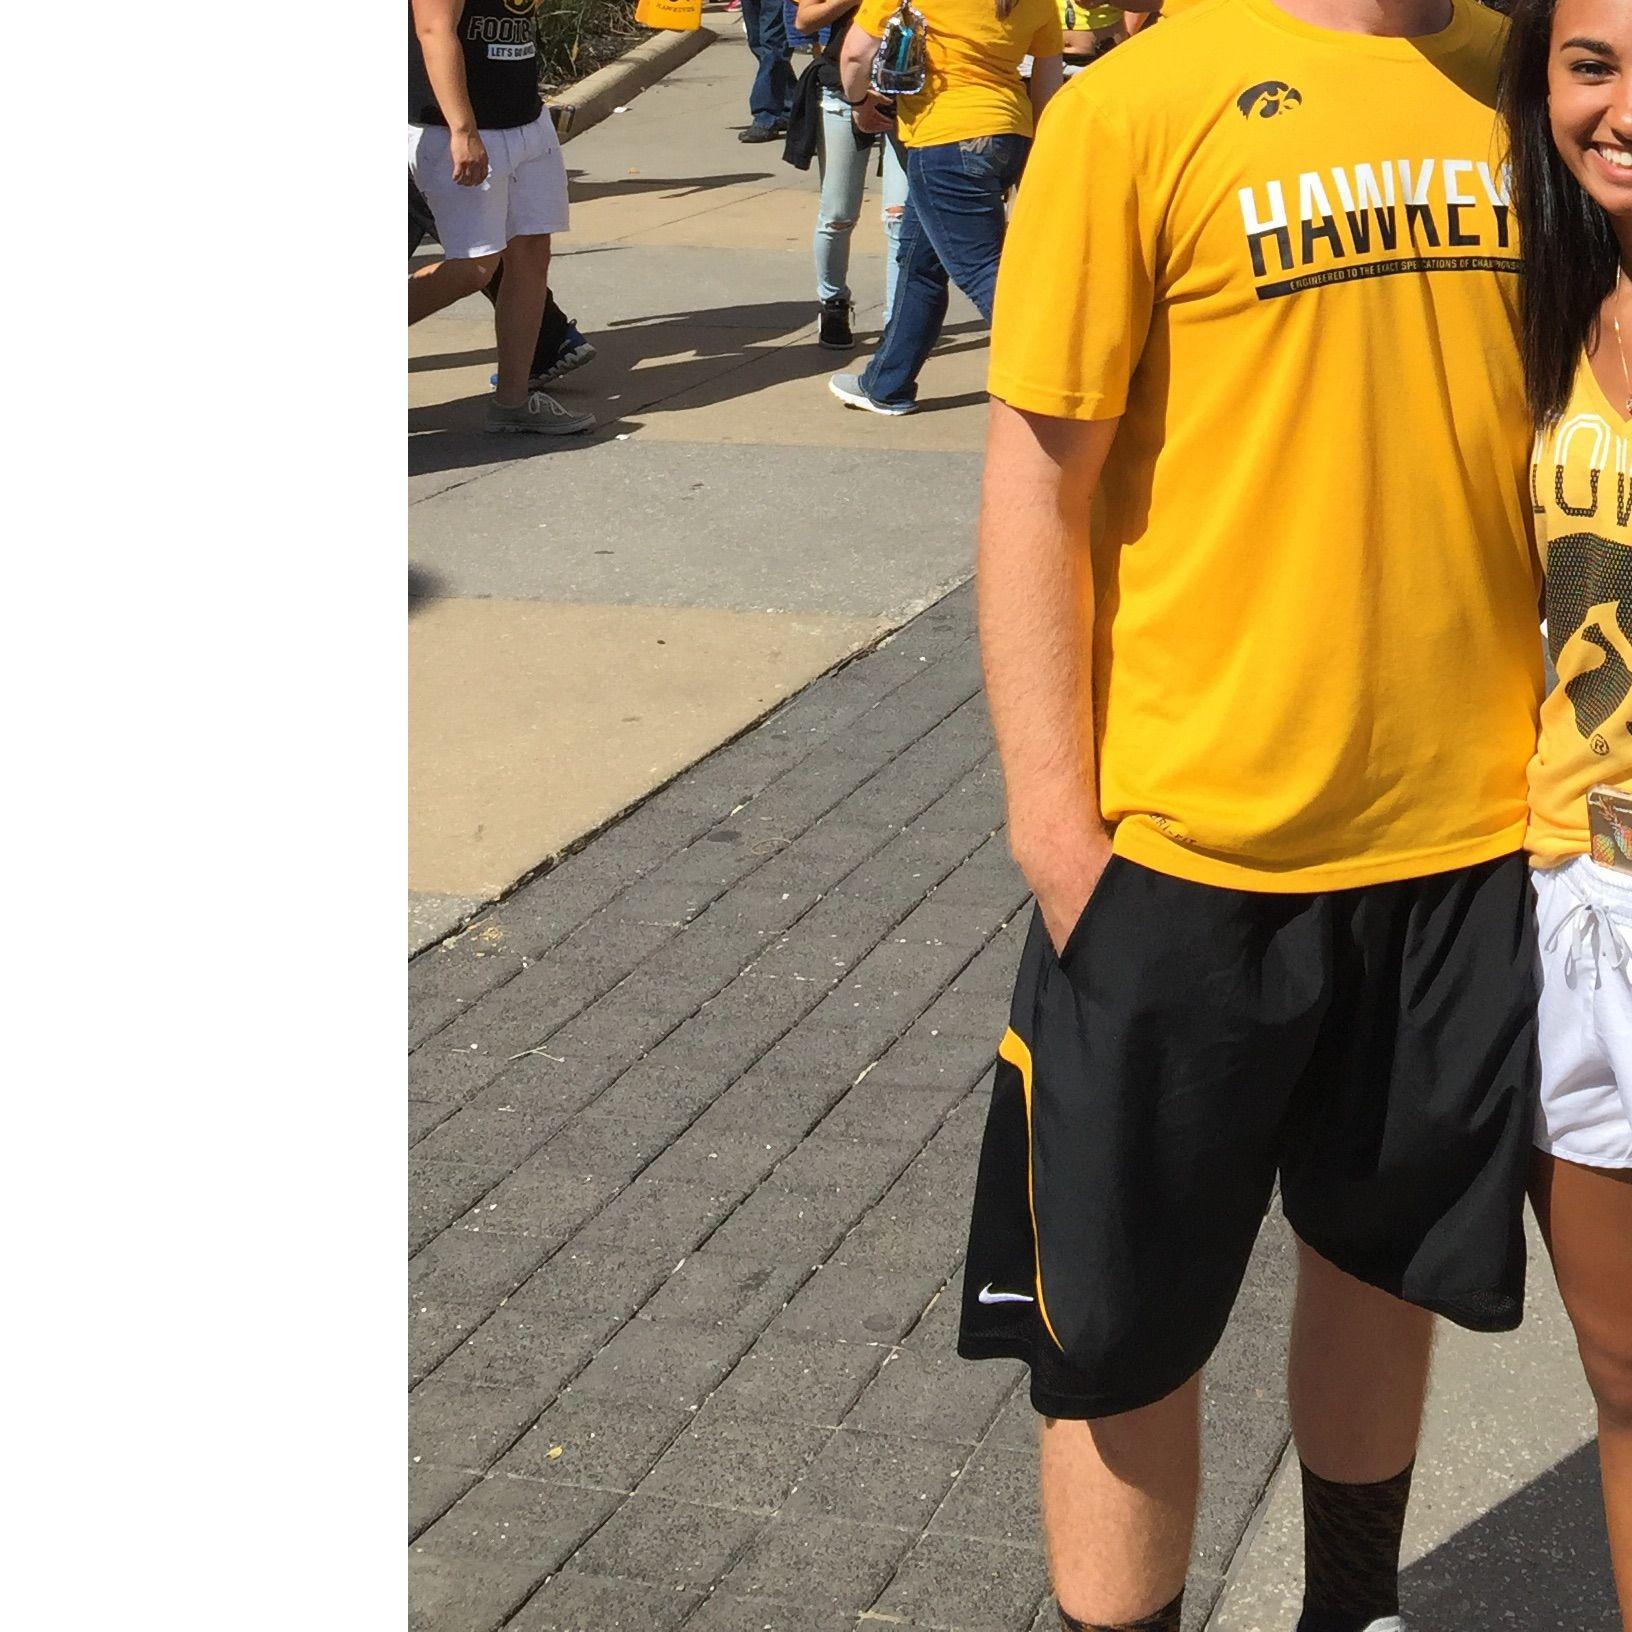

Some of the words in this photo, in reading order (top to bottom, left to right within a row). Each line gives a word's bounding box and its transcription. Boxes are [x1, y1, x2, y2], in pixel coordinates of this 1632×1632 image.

[491, 47, 513, 58] LET'S
[1289, 271, 1345, 291] ENGINEERED
[1347, 269, 1358, 279] TO
[1359, 265, 1375, 276] THE
[1376, 262, 1399, 274] EXACT
[1459, 259, 1470, 269] OF
